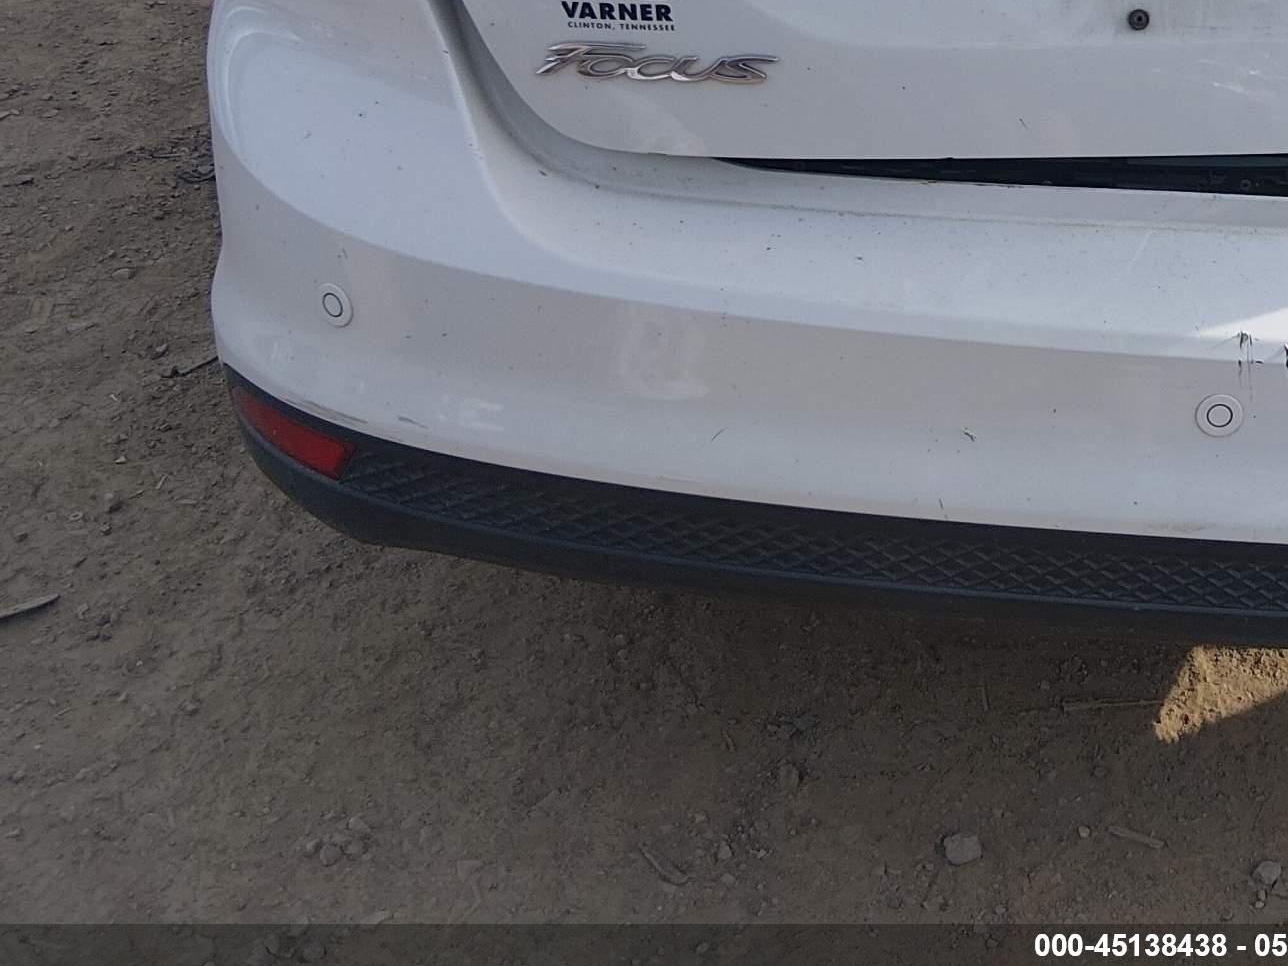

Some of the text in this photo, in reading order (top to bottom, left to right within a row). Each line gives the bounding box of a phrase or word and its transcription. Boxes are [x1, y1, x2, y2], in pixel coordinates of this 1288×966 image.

[561, 1, 673, 22] VARNER
[568, 21, 676, 32] CLINTON, TENNESSEE
